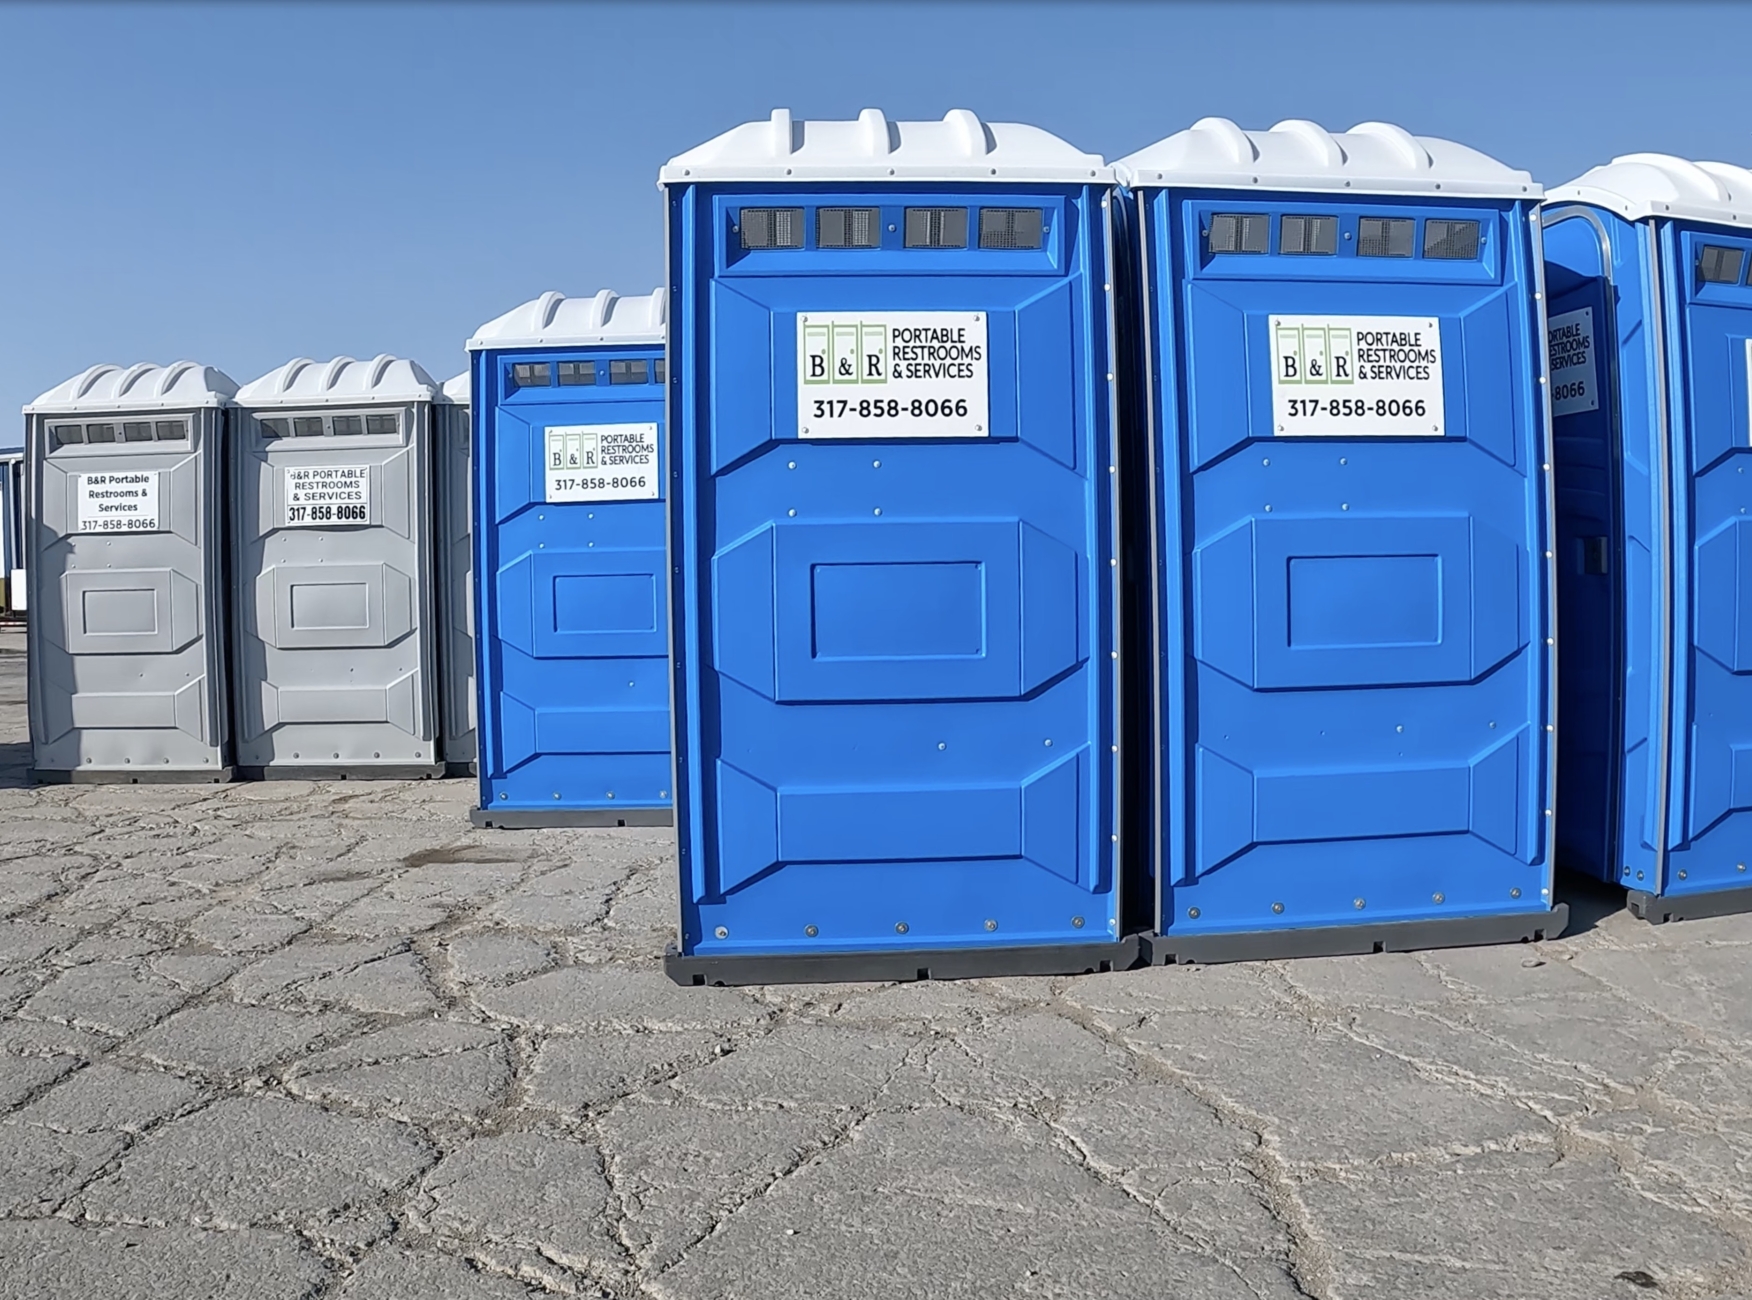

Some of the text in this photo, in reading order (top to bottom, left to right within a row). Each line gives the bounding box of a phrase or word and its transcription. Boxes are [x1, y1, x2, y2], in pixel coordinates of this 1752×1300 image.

[892, 328, 966, 344] PORTABLE
[1356, 332, 1422, 347] PORTABLE
[1548, 323, 1581, 343] ORTABLE
[892, 345, 982, 361] RESTROOMS
[1549, 335, 1590, 357] ESTROOMS
[1358, 348, 1436, 364] RESTROOMS
[810, 354, 882, 377] B & R
[892, 363, 973, 379] & SERVICES
[1283, 355, 1349, 378] B & R
[1358, 365, 1430, 380] & SERVICES
[813, 399, 968, 418] 317-858-8066
[1287, 399, 1426, 417] 317-858-8066
[600, 433, 645, 444] PORTABLE
[600, 444, 654, 455] RESTROOMS
[552, 451, 595, 466] B & R
[600, 455, 650, 465] & SERVICES
[87, 474, 150, 485] B&R Portable
[312, 469, 366, 479] PORTABLE
[294, 480, 360, 490] RESTROOMS
[554, 476, 646, 491] 317-858-8066
[88, 488, 148, 499] Restrooms &
[292, 491, 362, 501] & SERVICES
[98, 502, 138, 512] Services
[289, 505, 366, 521] 317-858-8066
[81, 518, 156, 531] 317-858-8066
